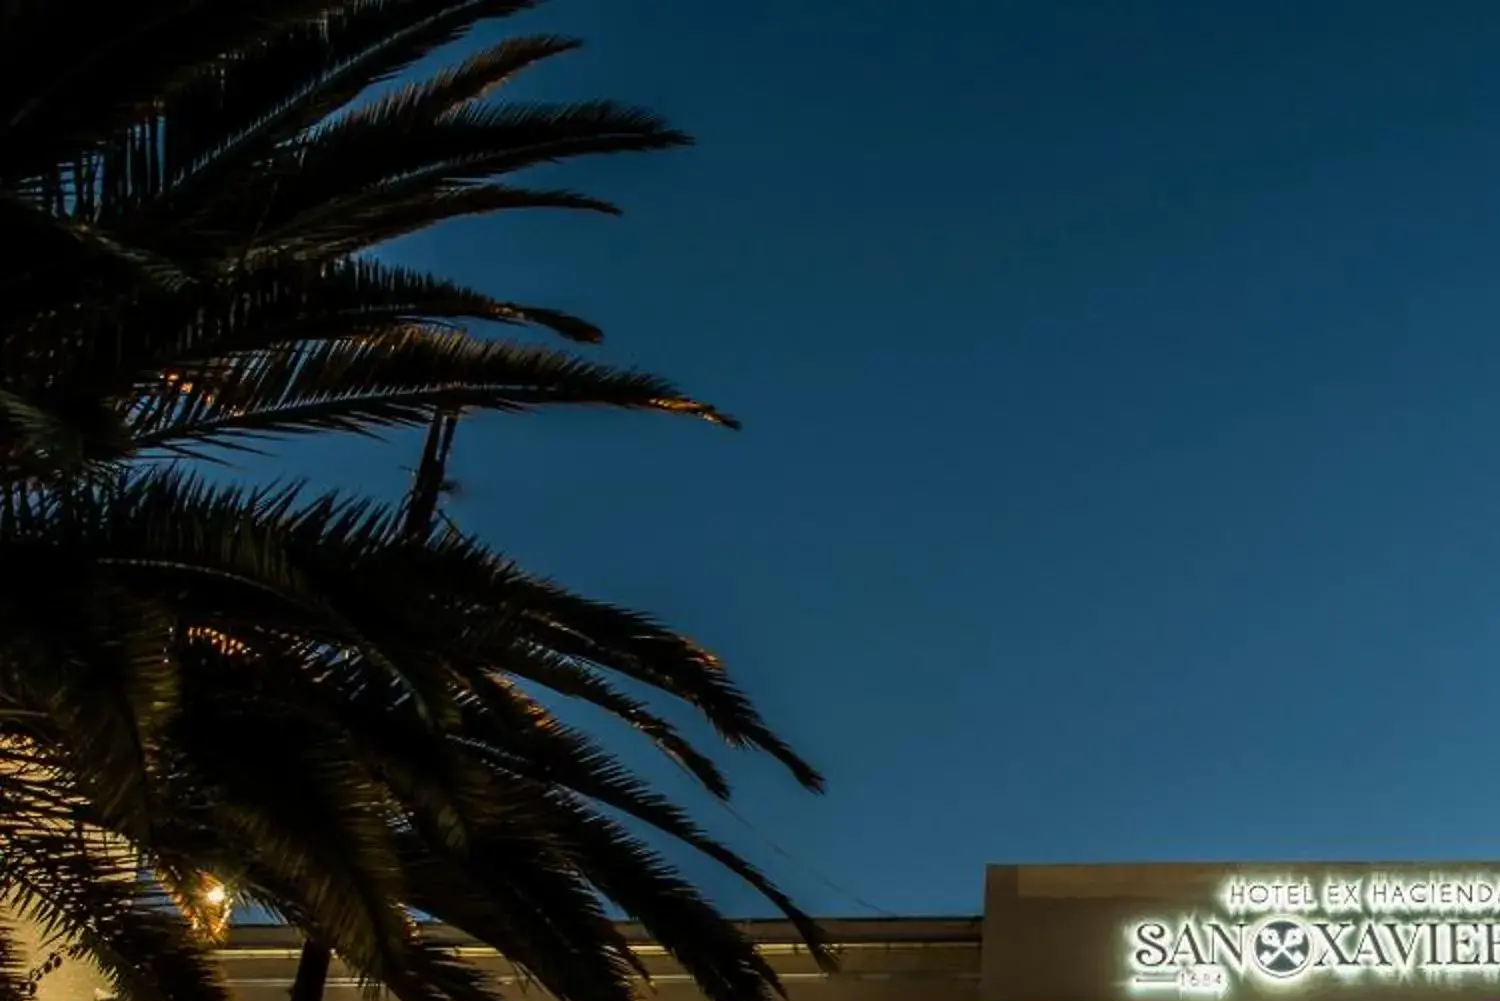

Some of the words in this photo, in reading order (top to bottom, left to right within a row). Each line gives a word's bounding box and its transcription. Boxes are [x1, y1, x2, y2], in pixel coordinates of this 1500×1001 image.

[1231, 884, 1315, 905] HOTEL
[1329, 884, 1359, 905] EX
[1136, 923, 1246, 967] SAN
